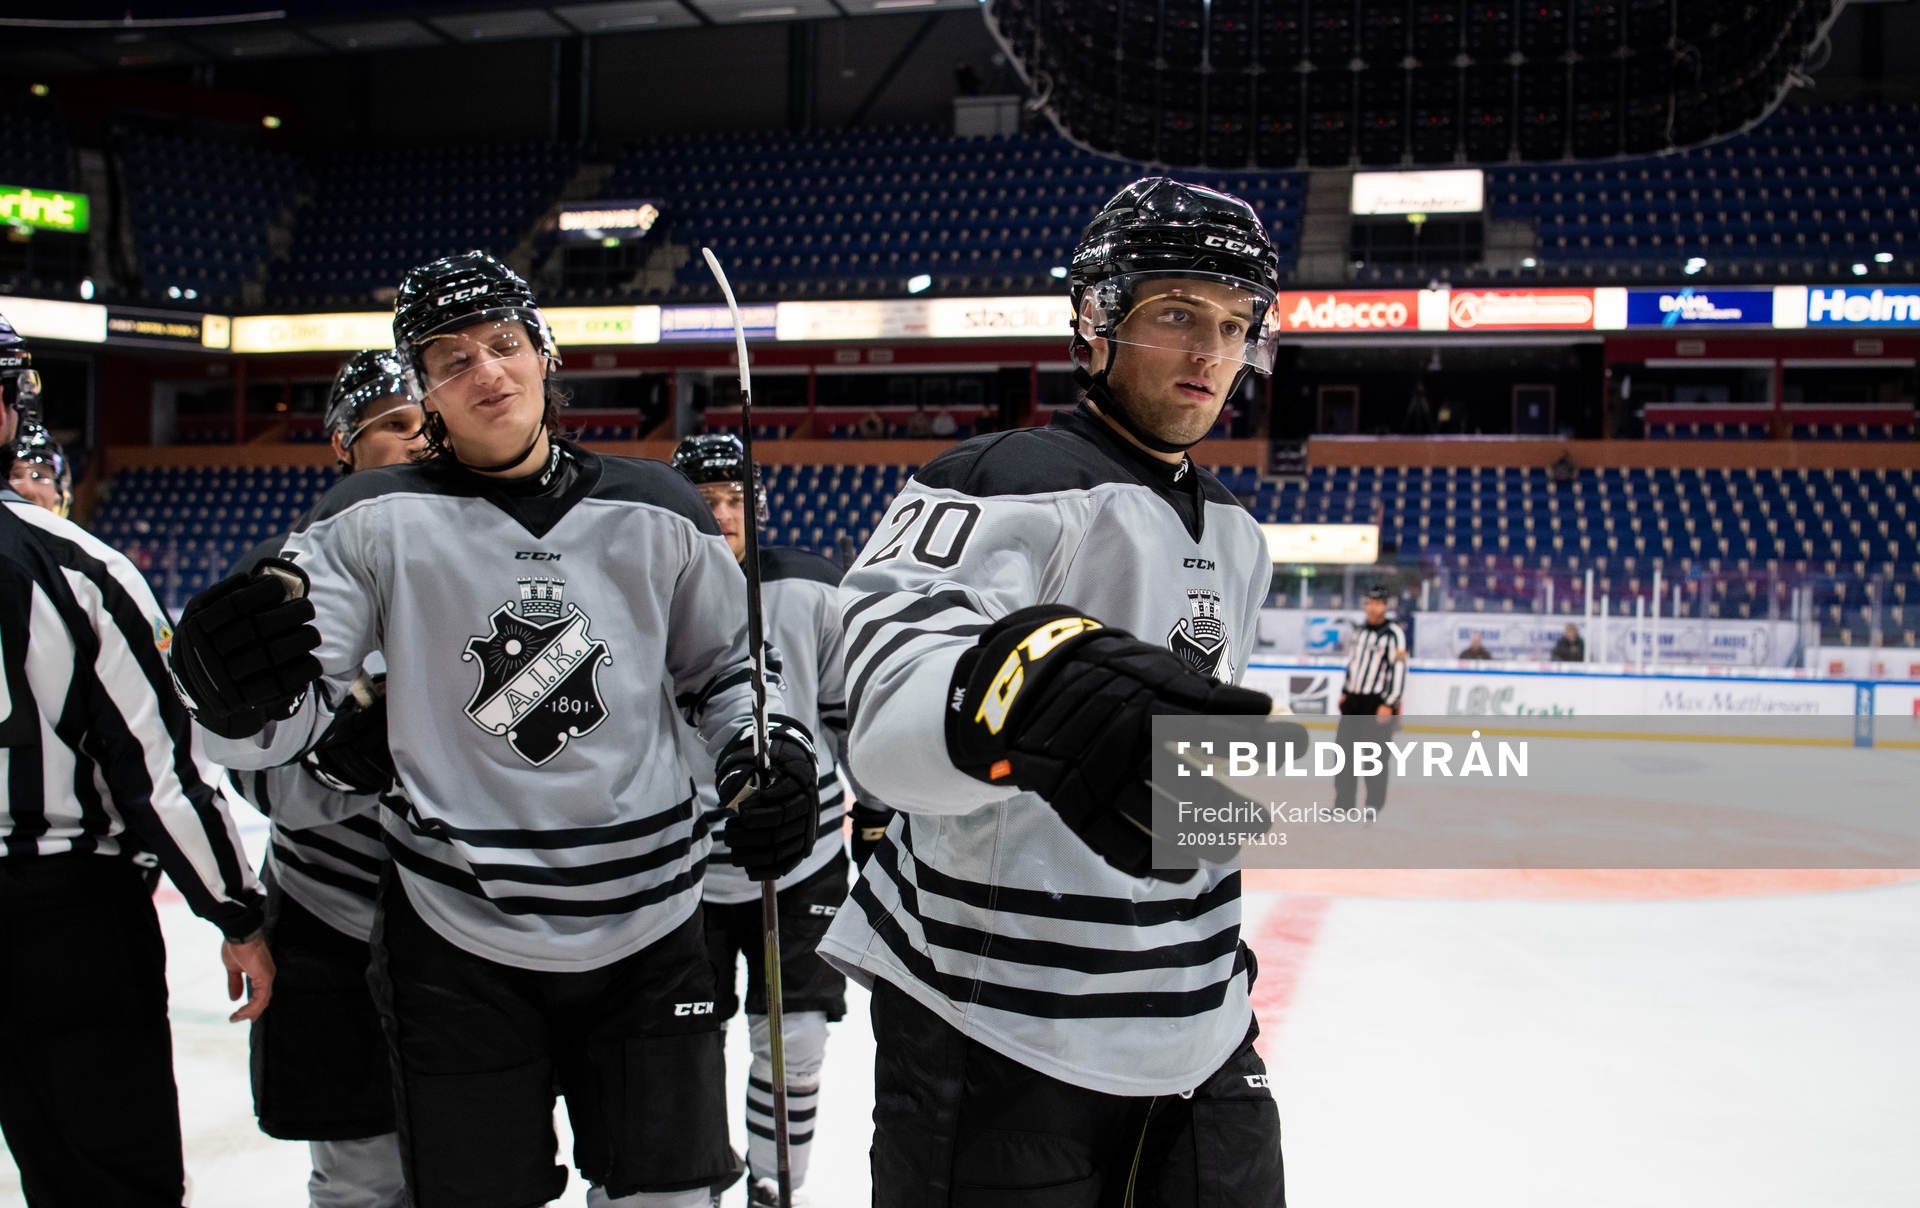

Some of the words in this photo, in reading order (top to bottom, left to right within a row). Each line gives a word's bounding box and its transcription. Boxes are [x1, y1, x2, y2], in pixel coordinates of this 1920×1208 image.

[1072, 247, 1100, 265] CCM
[1204, 235, 1261, 257] CCM
[437, 284, 489, 307] CCM
[1289, 295, 1408, 329] Adecco
[860, 497, 982, 569] 20
[515, 551, 562, 561] CCM
[1183, 558, 1215, 571] CCM
[951, 686, 967, 712] AIK
[810, 903, 842, 916] CC
[673, 1001, 715, 1017] CCM
